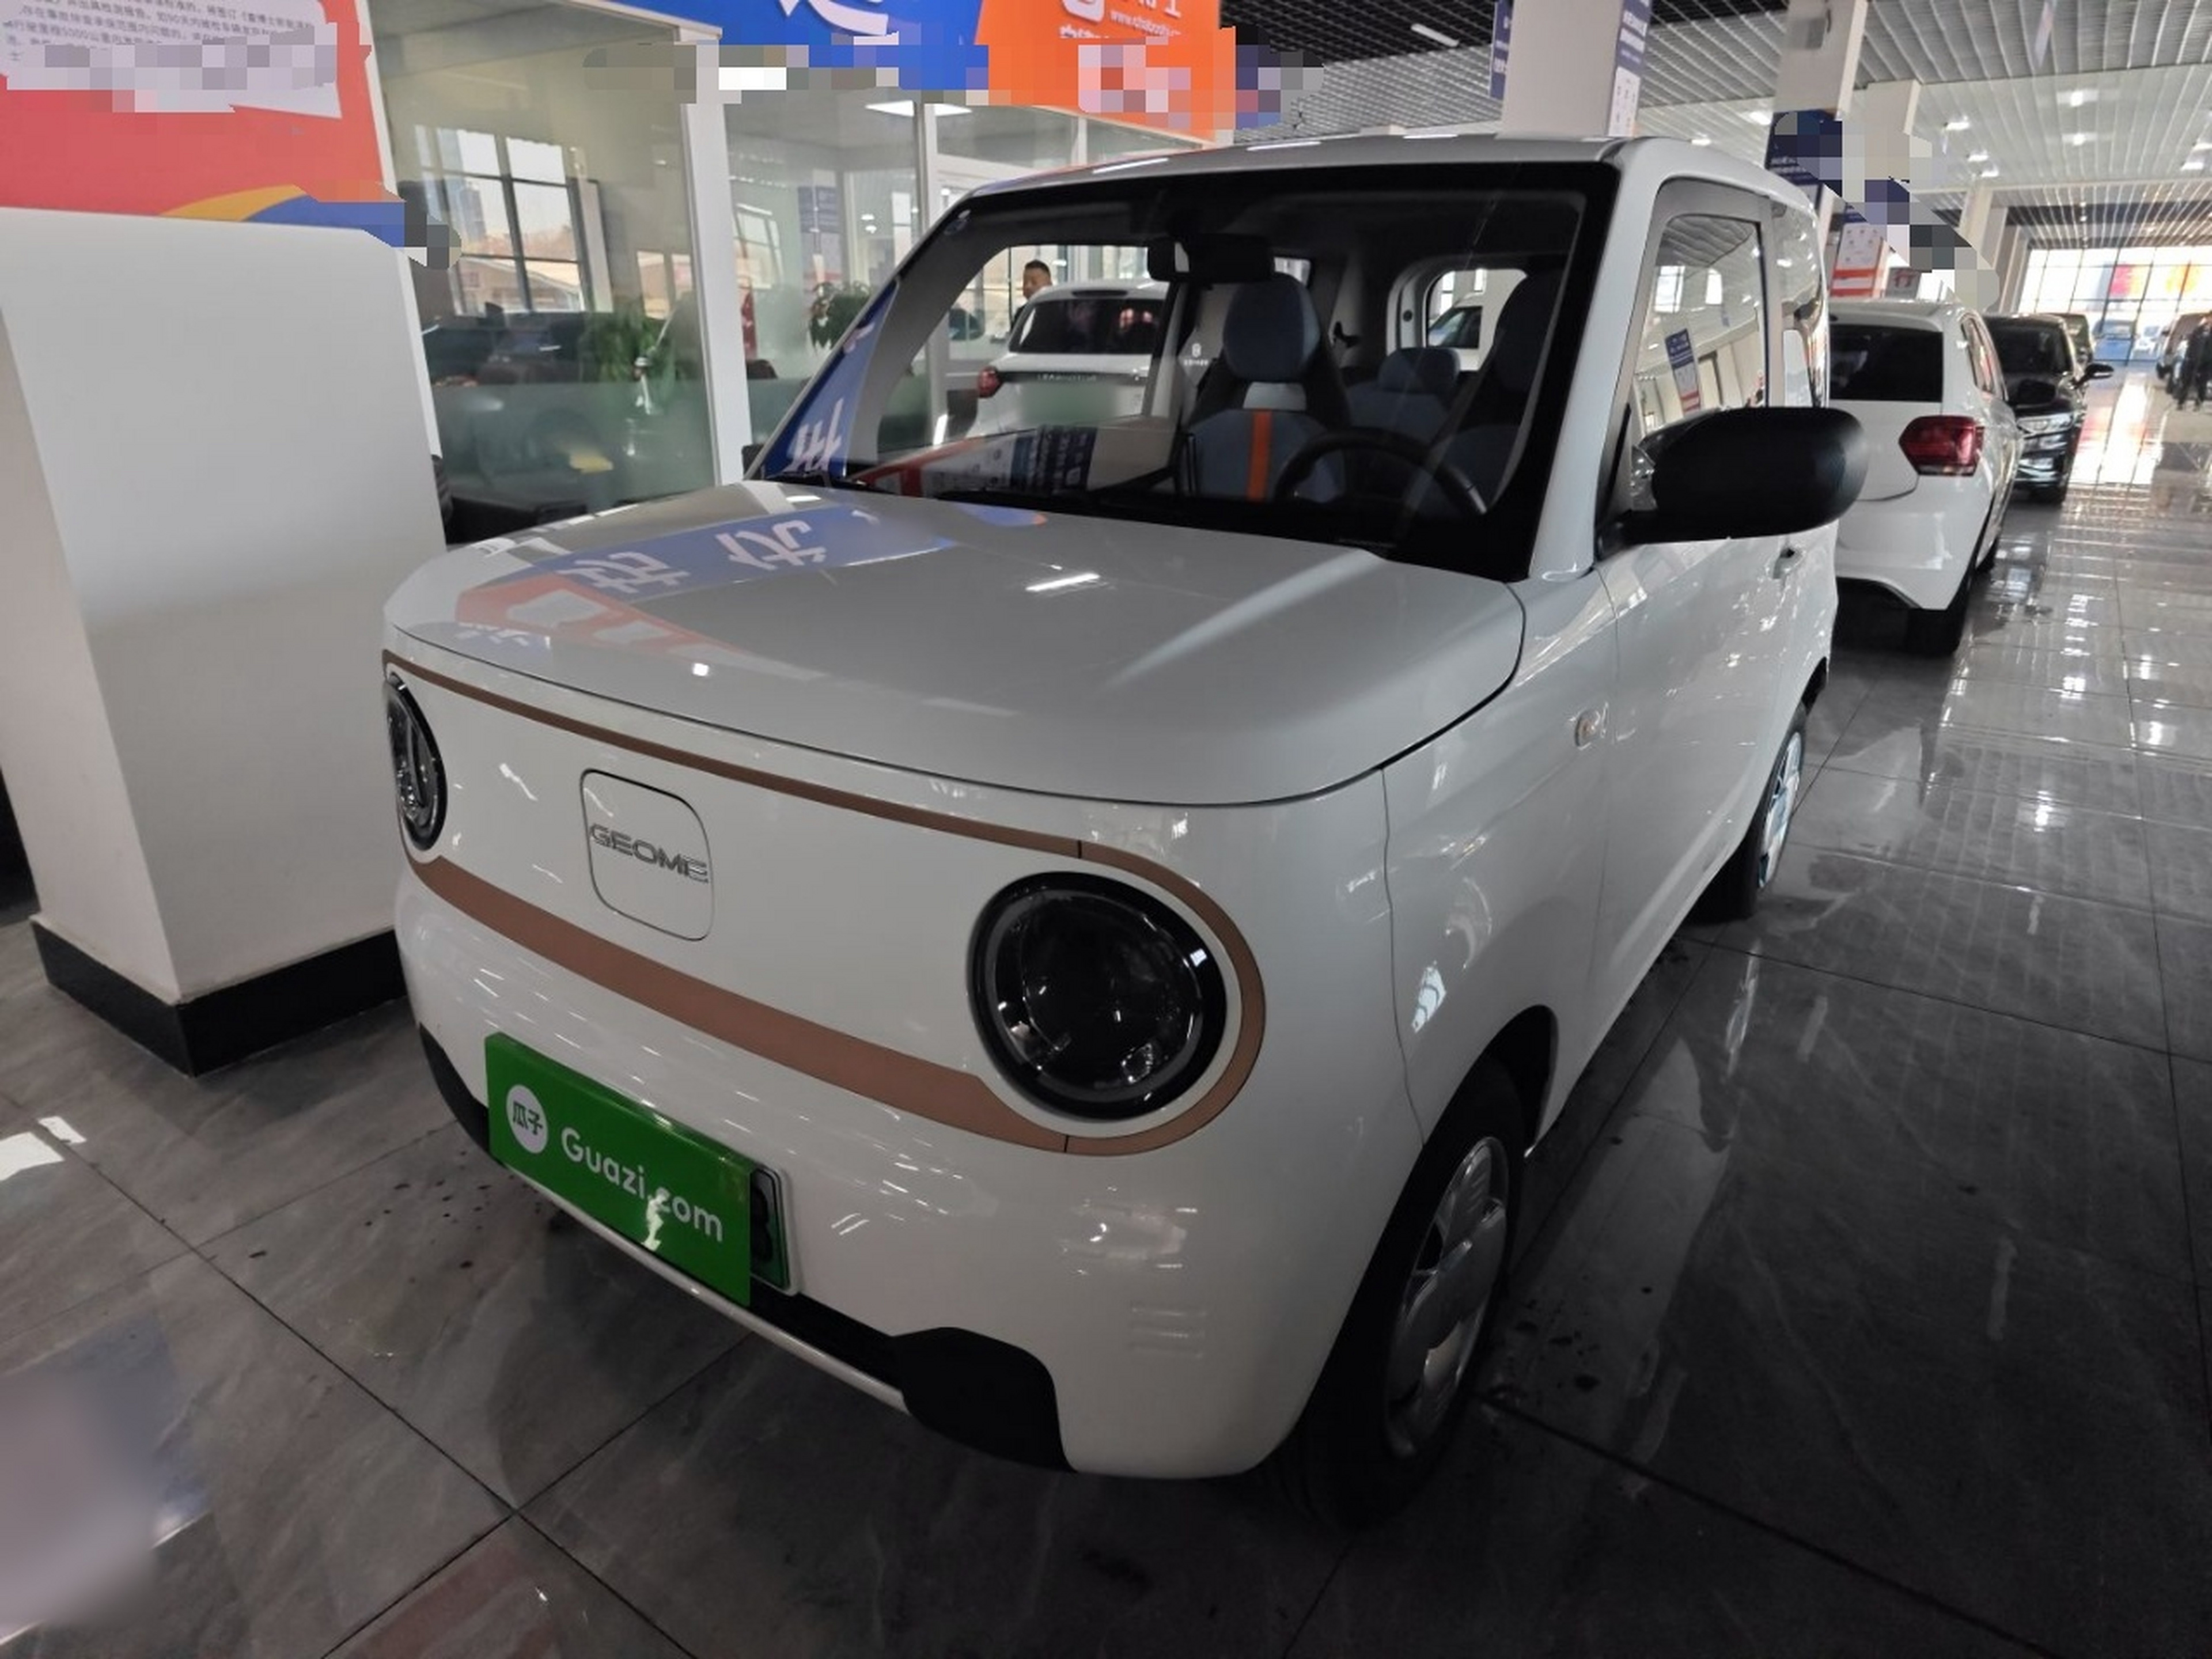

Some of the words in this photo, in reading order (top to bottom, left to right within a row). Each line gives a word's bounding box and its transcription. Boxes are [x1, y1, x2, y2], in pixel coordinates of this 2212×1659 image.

[589, 823, 709, 884] GEOME
[512, 1101, 544, 1136] 瓜子
[560, 1126, 724, 1243] Guazi.com
